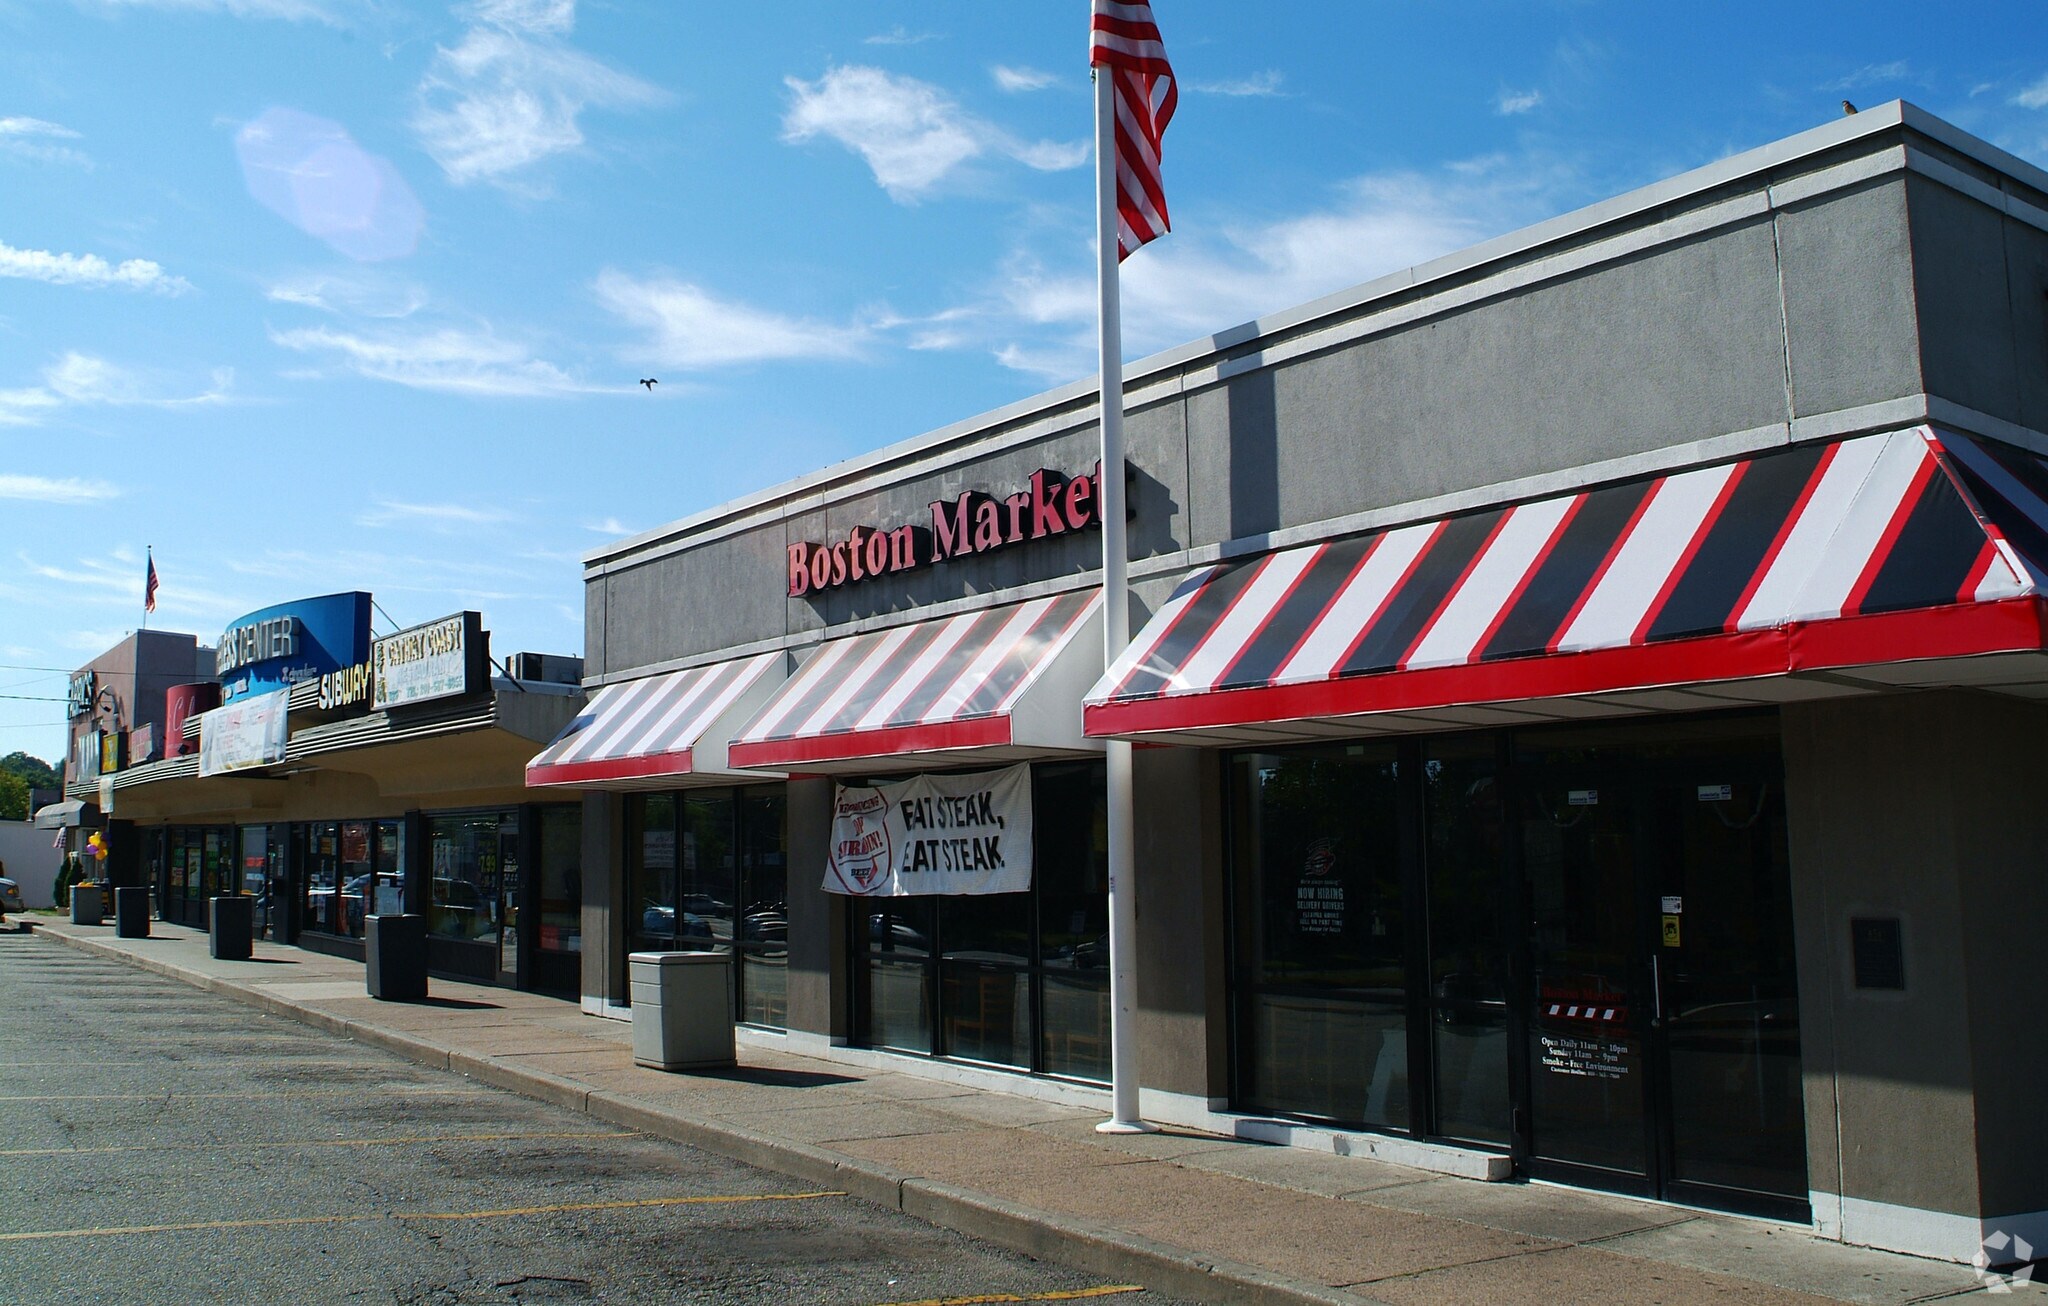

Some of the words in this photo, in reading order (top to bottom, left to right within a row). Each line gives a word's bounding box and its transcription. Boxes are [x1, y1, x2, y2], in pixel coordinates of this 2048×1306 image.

[788, 523, 915, 597] Boston
[240, 615, 293, 667] CENTER
[318, 661, 372, 710] SUBWAY
[900, 797, 935, 831] EAT
[937, 791, 1004, 830] STEAK,
[902, 840, 939, 872] EAT
[942, 835, 1005, 872] STEAK.
[1297, 887, 1315, 900] NOW
[1317, 887, 1344, 900] HIRING
[1541, 1036, 1558, 1047] Open
[1560, 1039, 1577, 1050] Daily
[1580, 1041, 1598, 1050] 11am
[1609, 1044, 1628, 1054] 10pm
[1549, 1047, 1572, 1058] Sunday
[1574, 1050, 1592, 1059] 11am
[1602, 1053, 1618, 1063] 9pm
[1542, 1056, 1564, 1067] Smoke
[1585, 1061, 1629, 1074] Environment
